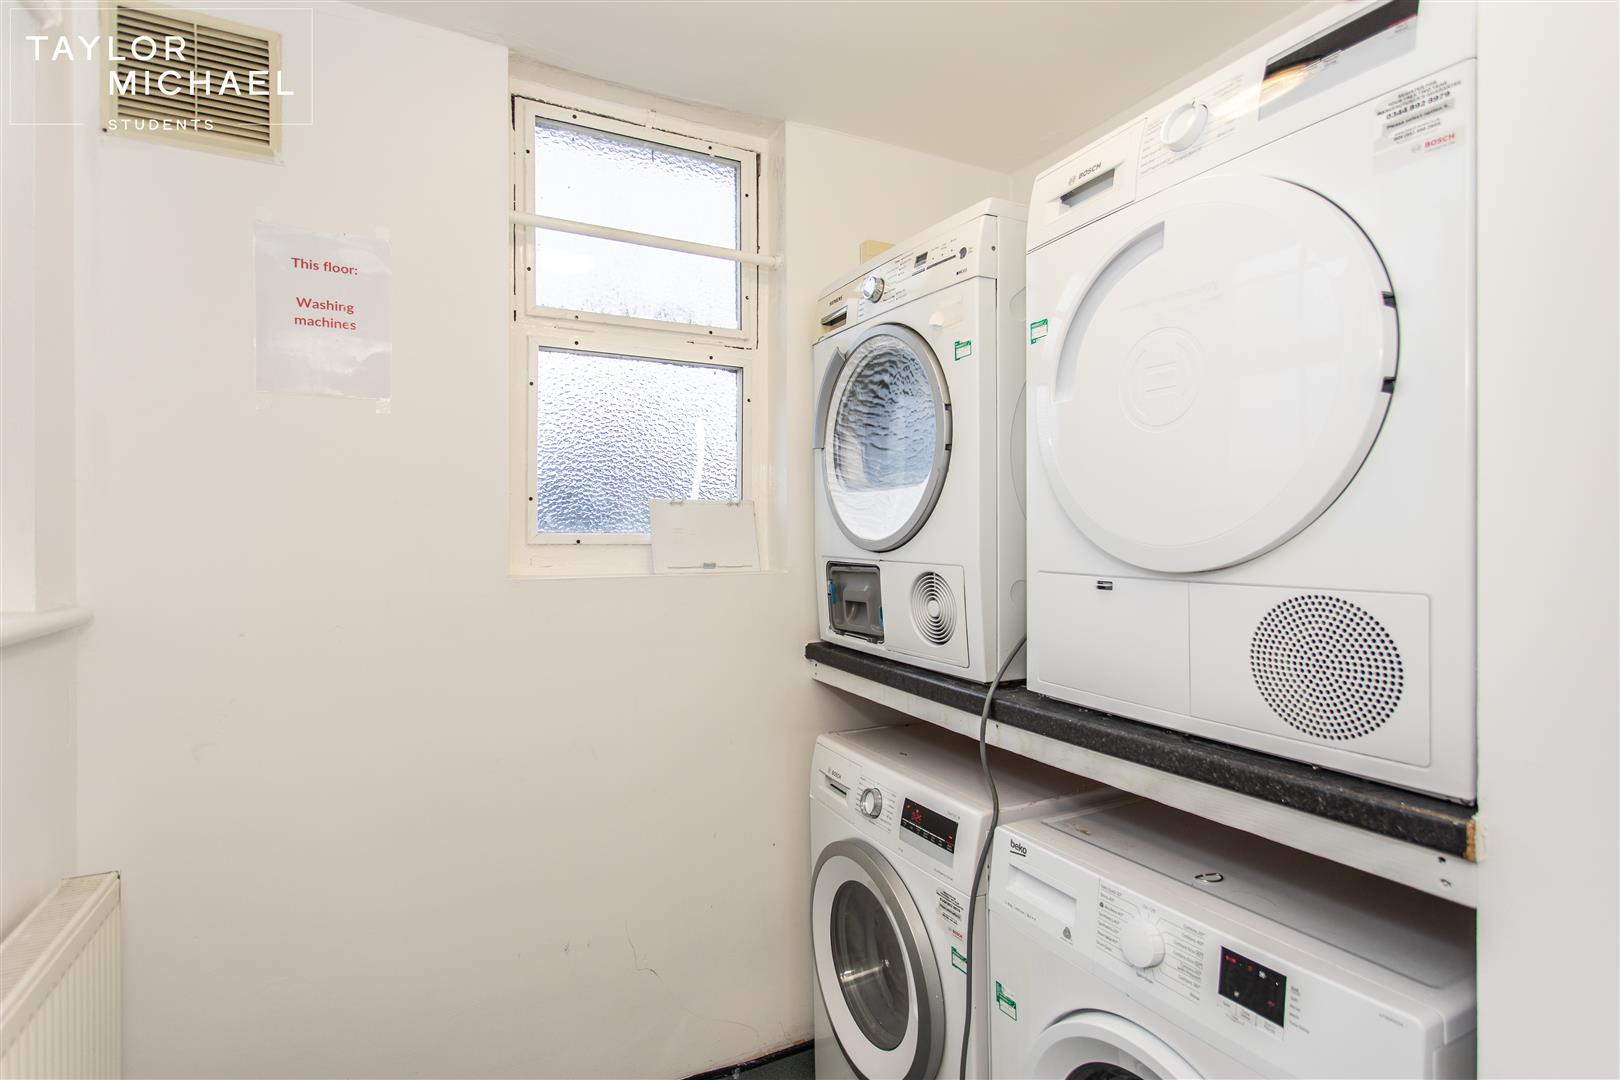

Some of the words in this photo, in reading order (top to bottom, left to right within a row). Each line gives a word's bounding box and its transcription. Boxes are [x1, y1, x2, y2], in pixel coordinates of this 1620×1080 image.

[1424, 133, 1456, 148] BOSCH
[1078, 161, 1102, 180] BOSCH
[291, 257, 320, 271] This
[323, 260, 358, 275] floor:
[296, 297, 355, 315] Washing
[294, 314, 357, 331] machines
[1010, 838, 1027, 854] beko
